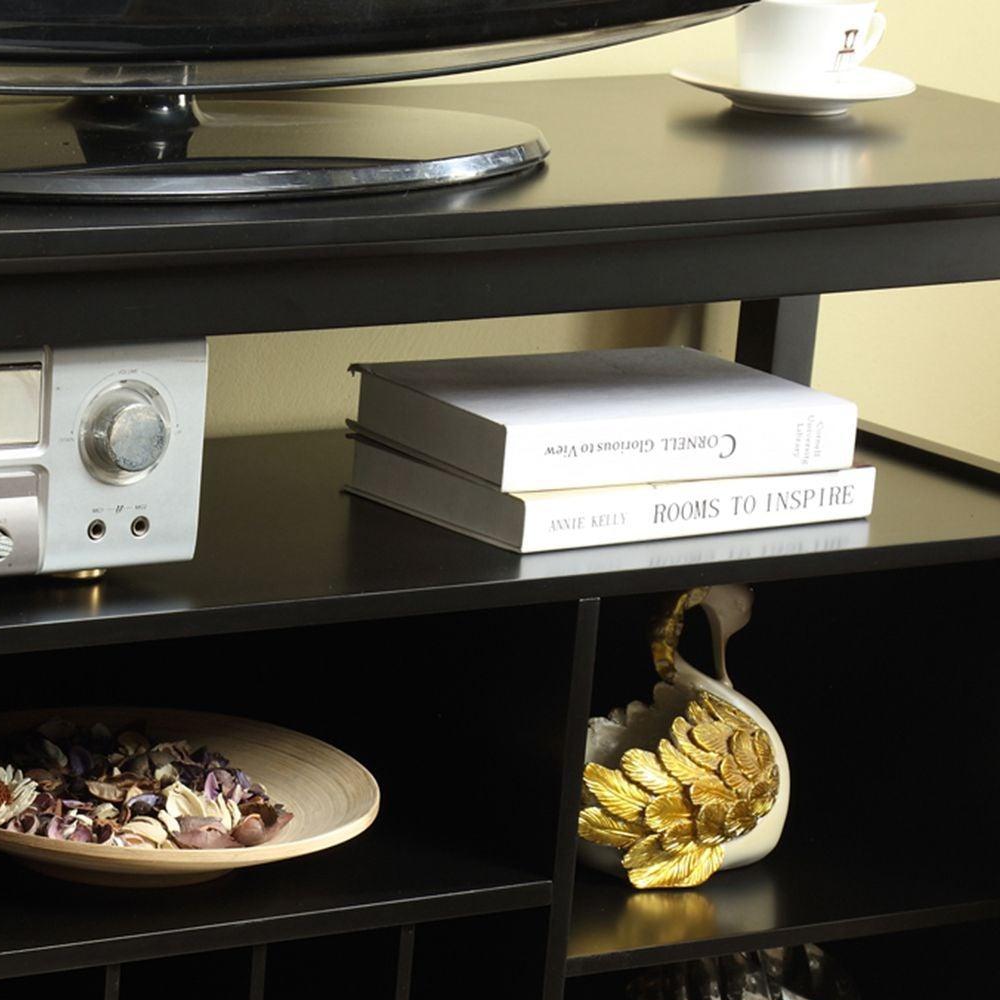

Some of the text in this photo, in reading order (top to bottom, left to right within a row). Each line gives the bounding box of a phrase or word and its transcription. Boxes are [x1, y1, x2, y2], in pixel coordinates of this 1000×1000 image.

[544, 433, 737, 459] CORNELL Glorious to View
[653, 484, 855, 524] ROOMS TO INSPIRE
[549, 512, 627, 532] ANNIE KELLY
